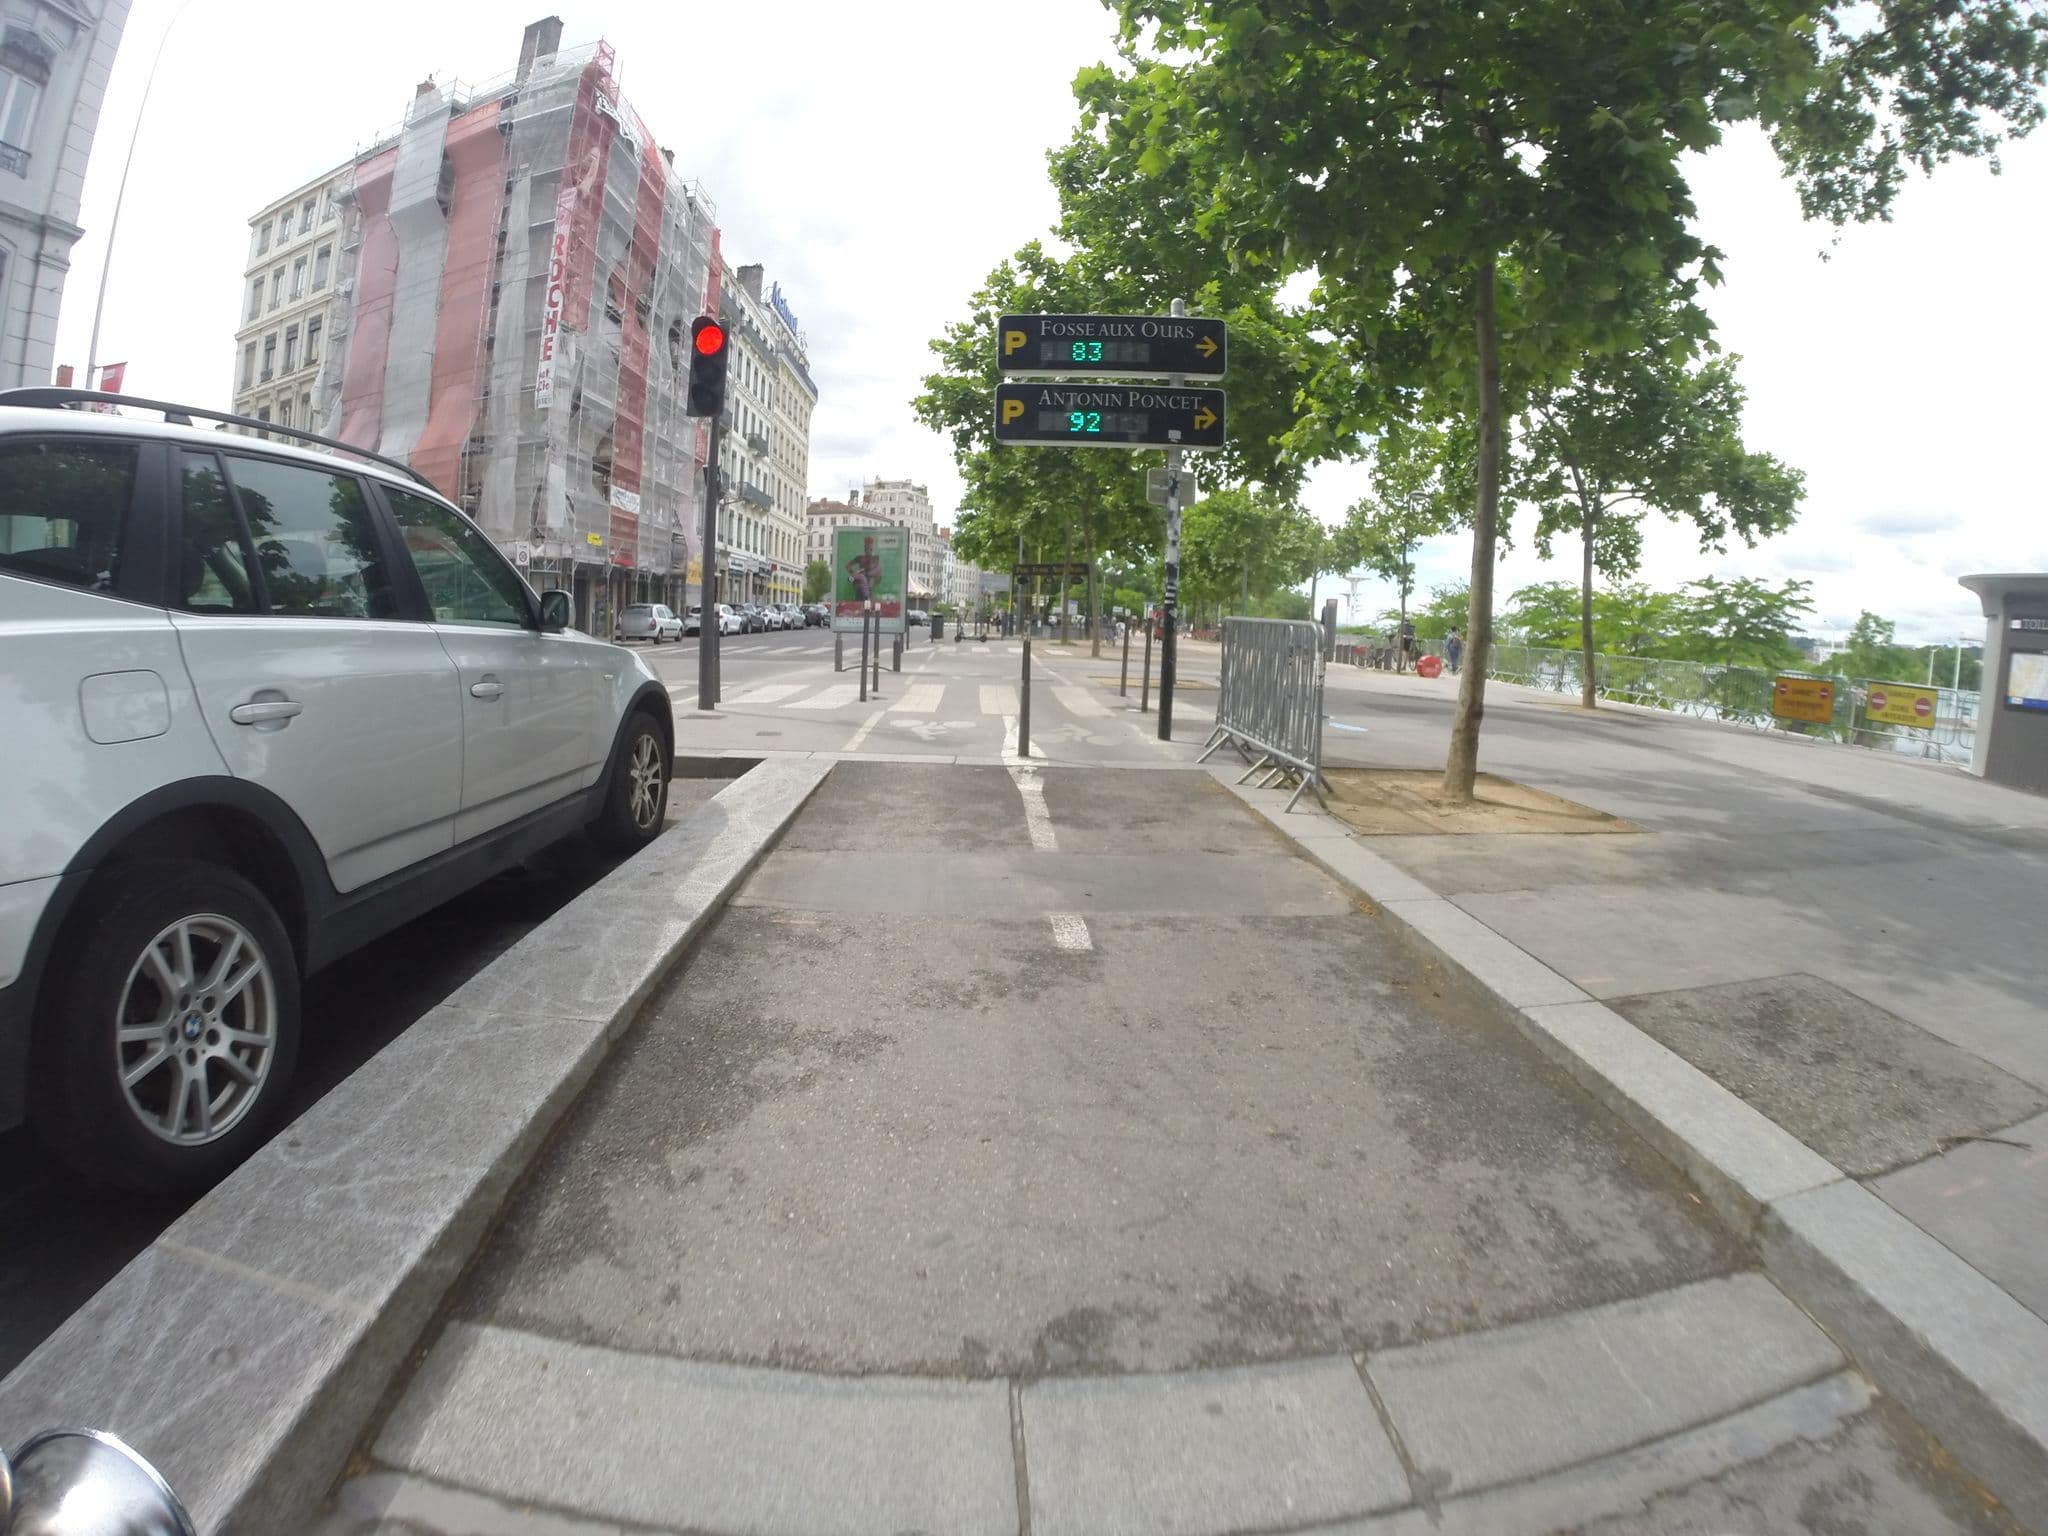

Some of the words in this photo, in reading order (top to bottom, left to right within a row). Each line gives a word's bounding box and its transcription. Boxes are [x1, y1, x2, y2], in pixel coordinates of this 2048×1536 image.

[543, 234, 565, 361] ROCHE
[1040, 320, 1095, 337] FOSSE
[1098, 323, 1135, 337] AUX
[1141, 321, 1195, 339] OURS
[1004, 330, 1027, 356] P
[1072, 341, 1103, 362] 83
[1038, 389, 1123, 407] ANTONIN
[1128, 391, 1203, 410] PONCET
[1002, 399, 1025, 425] P
[1069, 411, 1101, 433] 92
